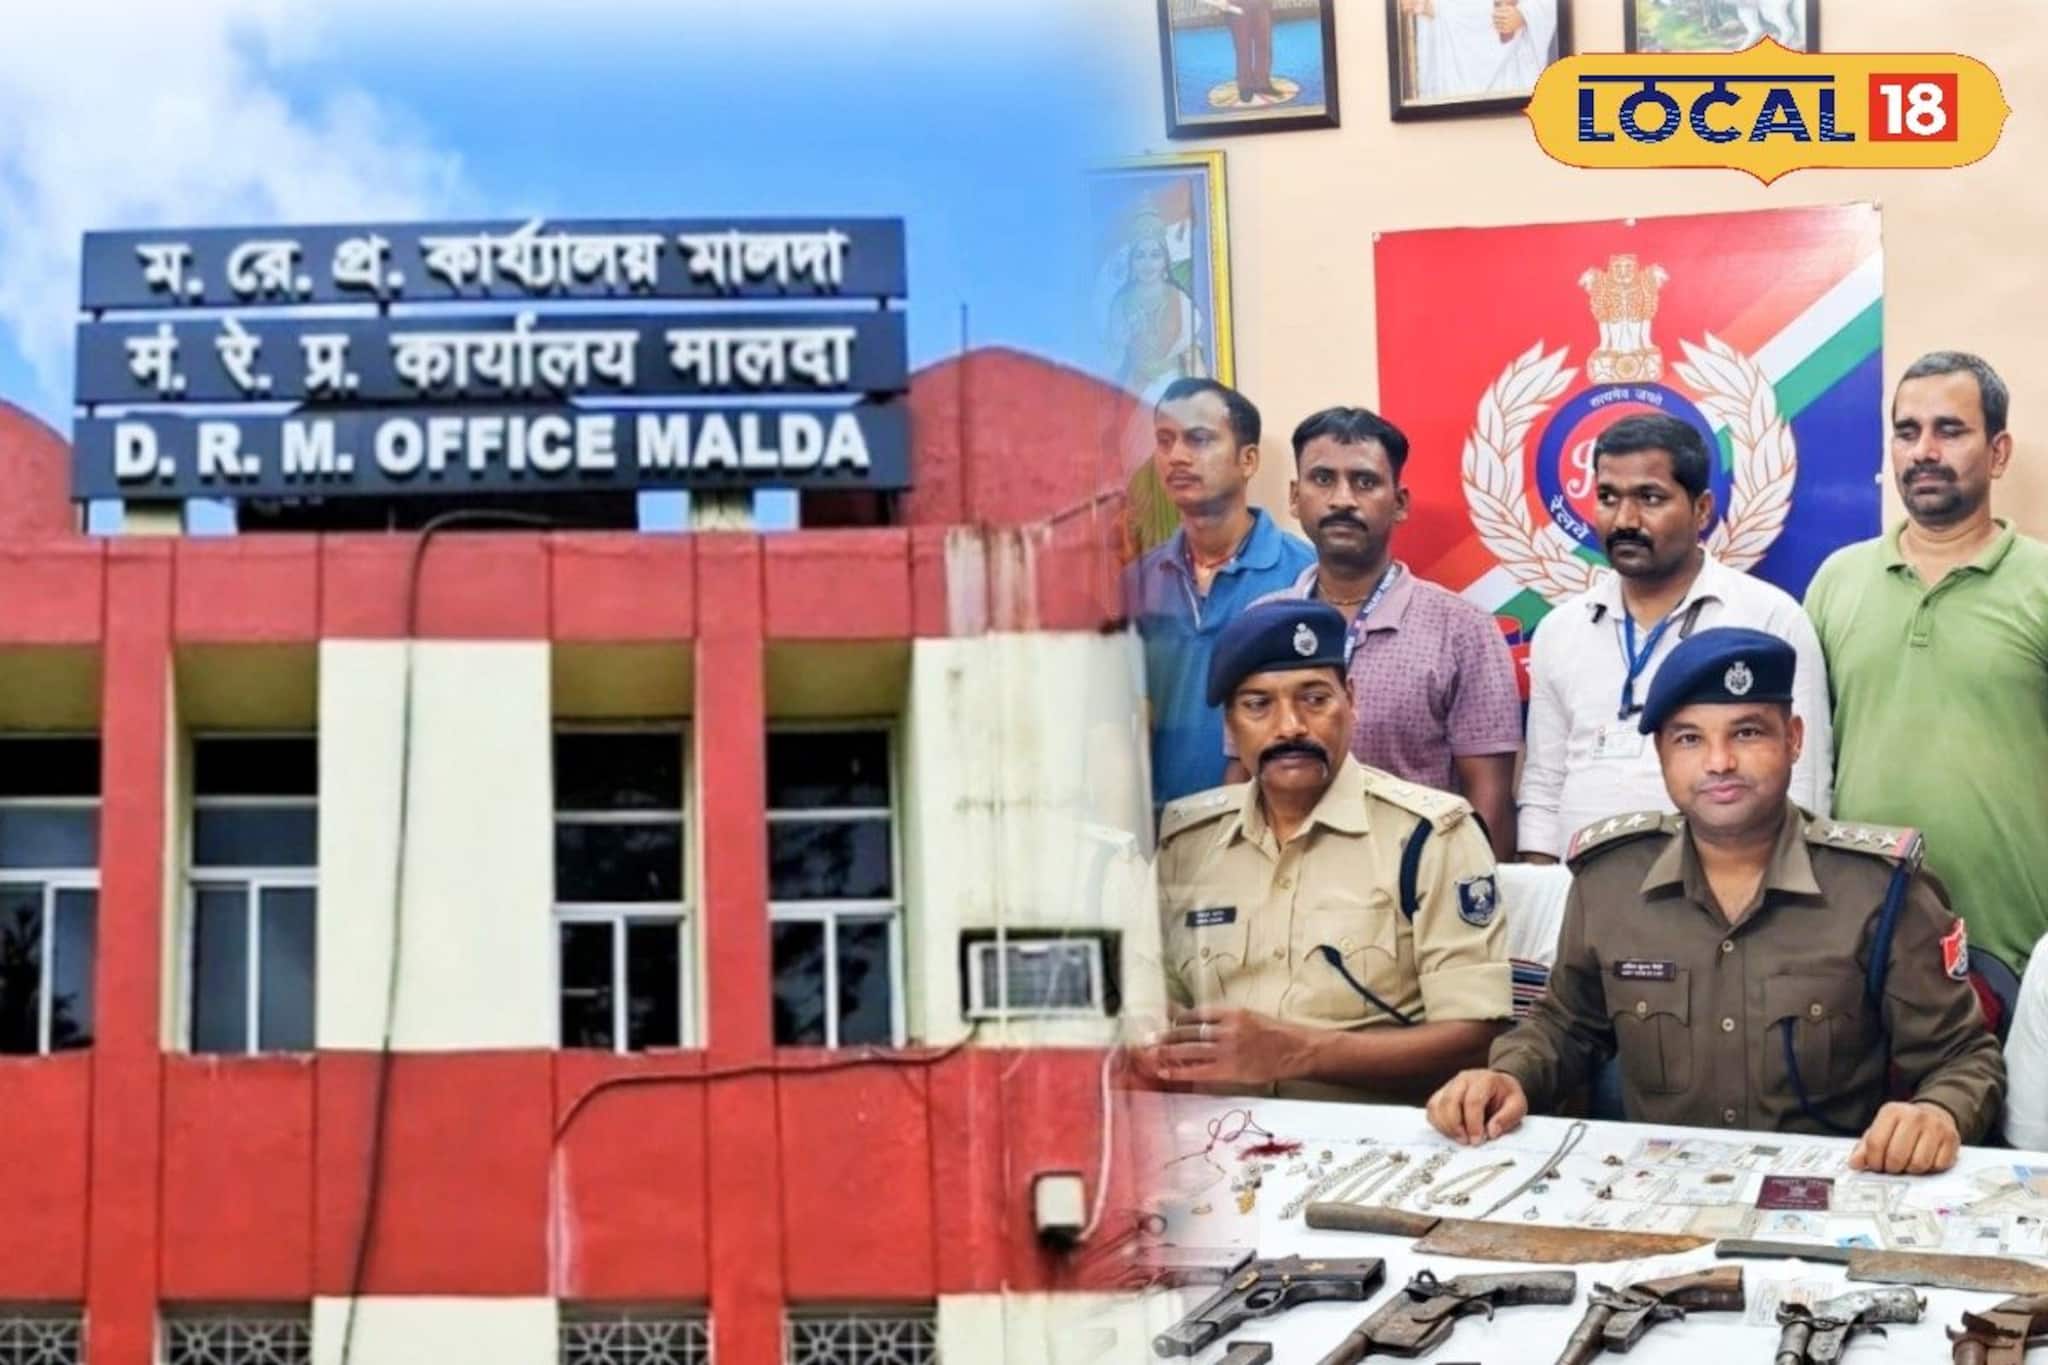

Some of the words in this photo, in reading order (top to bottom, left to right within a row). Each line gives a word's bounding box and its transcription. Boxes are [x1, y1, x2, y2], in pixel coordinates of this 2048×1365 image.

[136, 243, 204, 295] ম.
[228, 240, 312, 294] রে.
[677, 229, 849, 285] মালদা
[125, 323, 186, 390] मं.
[215, 316, 273, 390] रे.
[300, 334, 359, 390] प्र.
[388, 309, 640, 388] कार्यालय
[665, 326, 857, 385] मालदा
[114, 422, 176, 477] D.
[198, 421, 261, 476] R.
[281, 419, 354, 475] M.
[375, 414, 617, 474] OFFICE
[636, 411, 872, 469] MALDA
